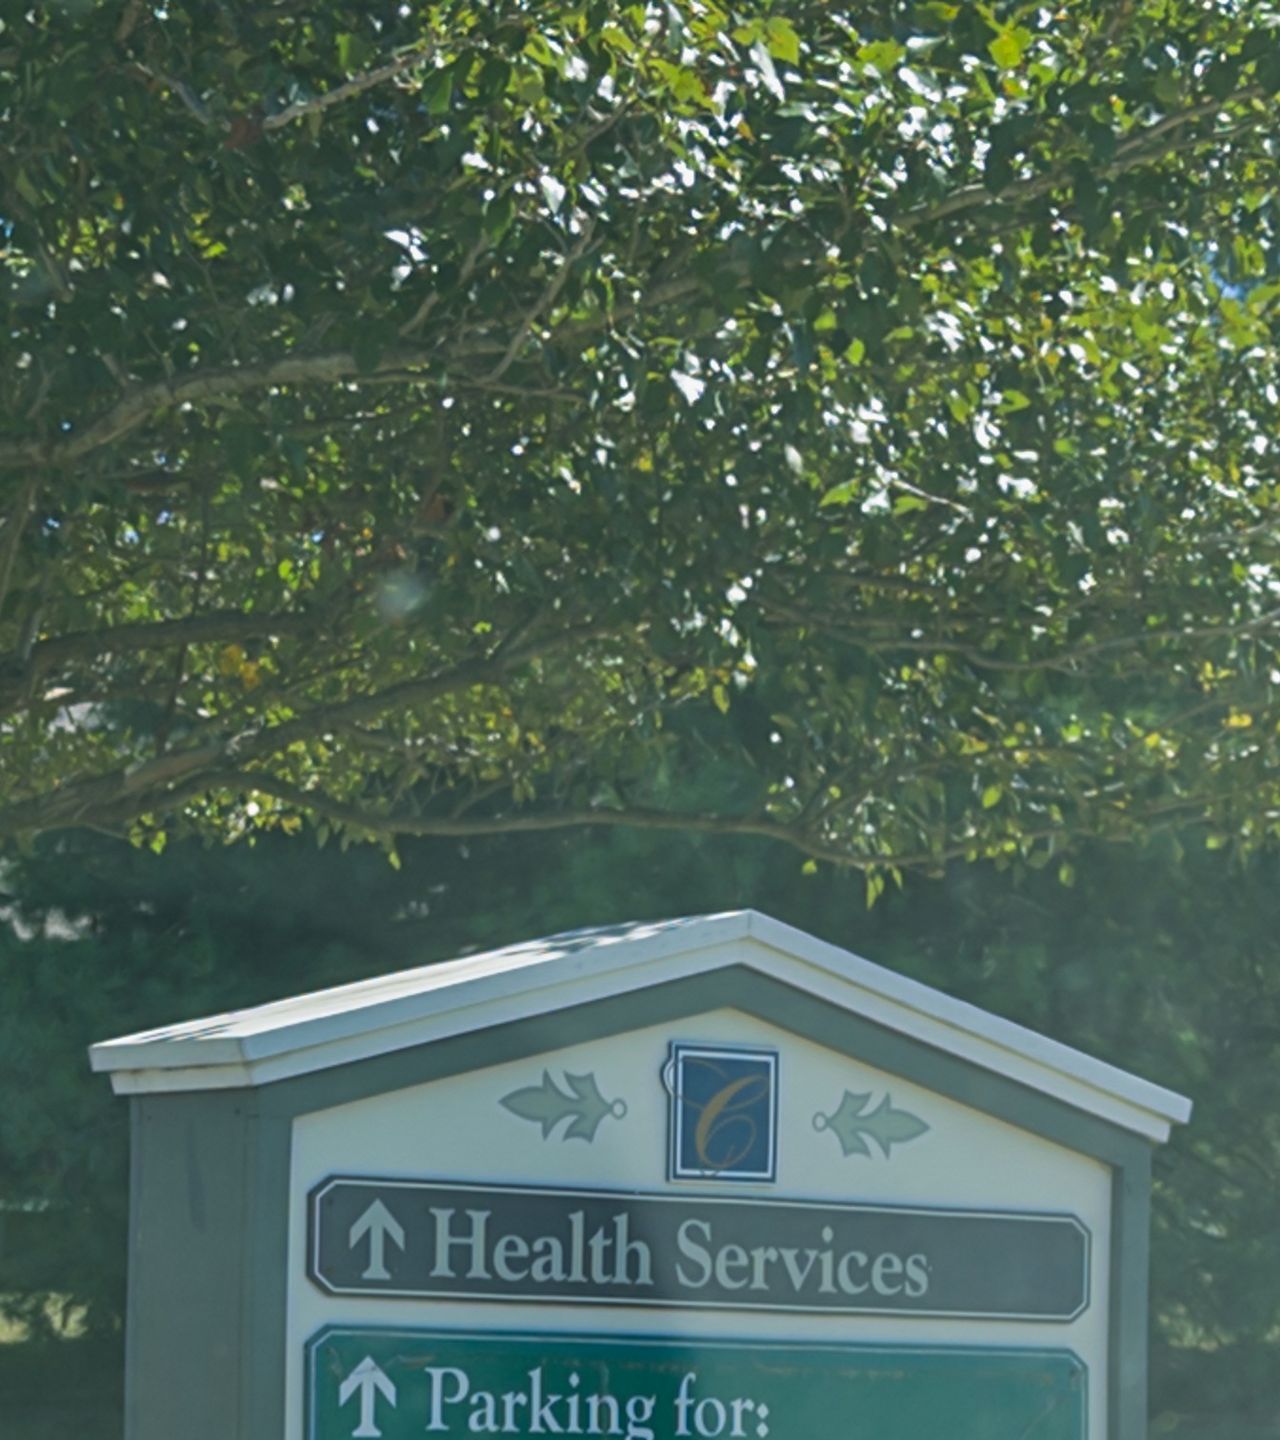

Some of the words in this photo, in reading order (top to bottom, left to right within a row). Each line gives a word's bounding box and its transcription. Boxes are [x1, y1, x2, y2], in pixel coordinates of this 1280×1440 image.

[429, 1208, 654, 1286] Health
[675, 1219, 929, 1297] Services
[675, 1374, 770, 1439] for:
